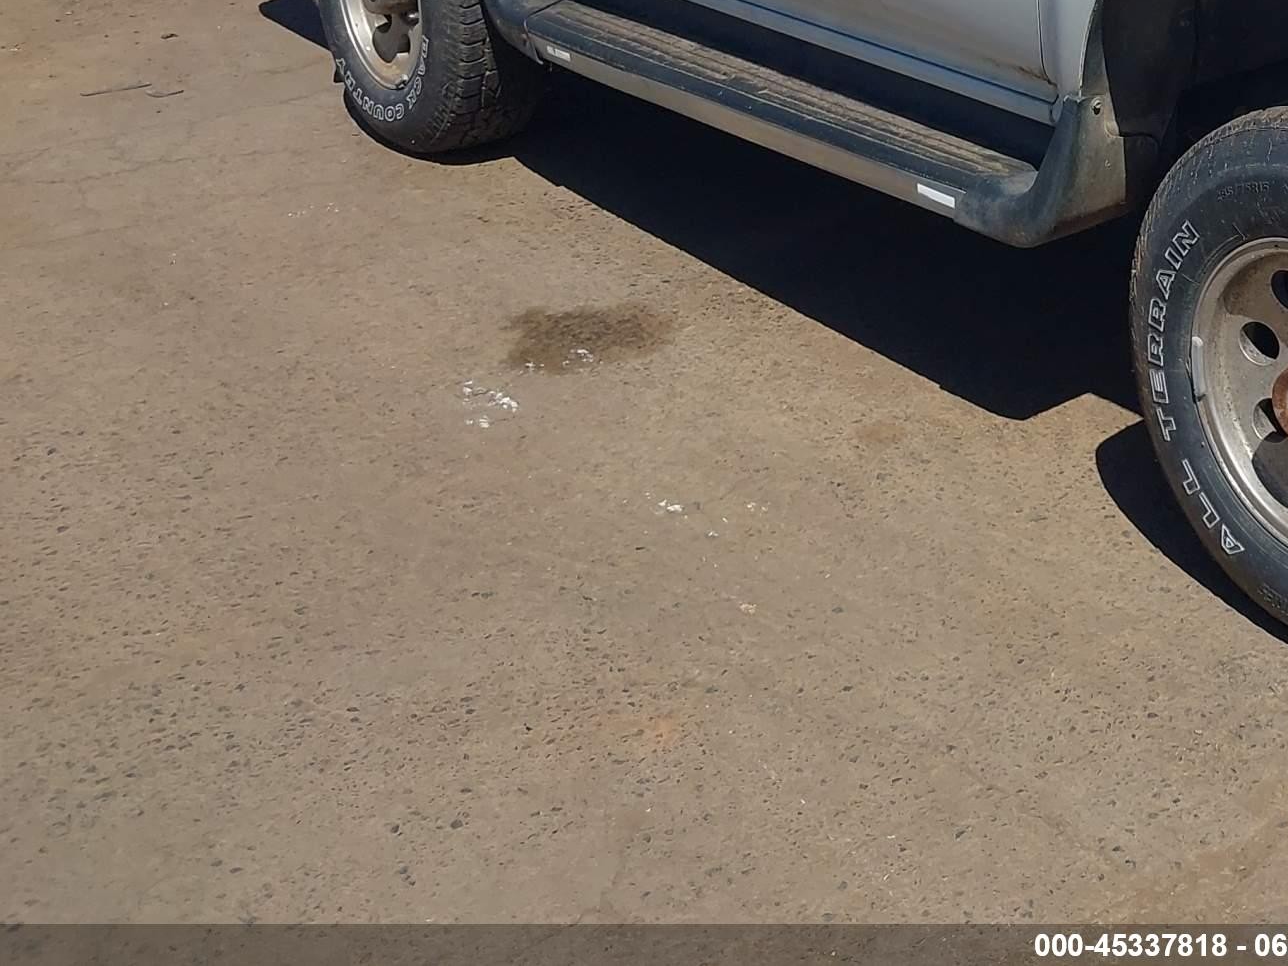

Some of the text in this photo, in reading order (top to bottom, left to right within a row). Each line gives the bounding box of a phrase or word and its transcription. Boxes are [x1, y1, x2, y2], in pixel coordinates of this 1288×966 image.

[335, 57, 405, 122] COUNTRY
[1149, 219, 1246, 556] ALL TERRAIN
